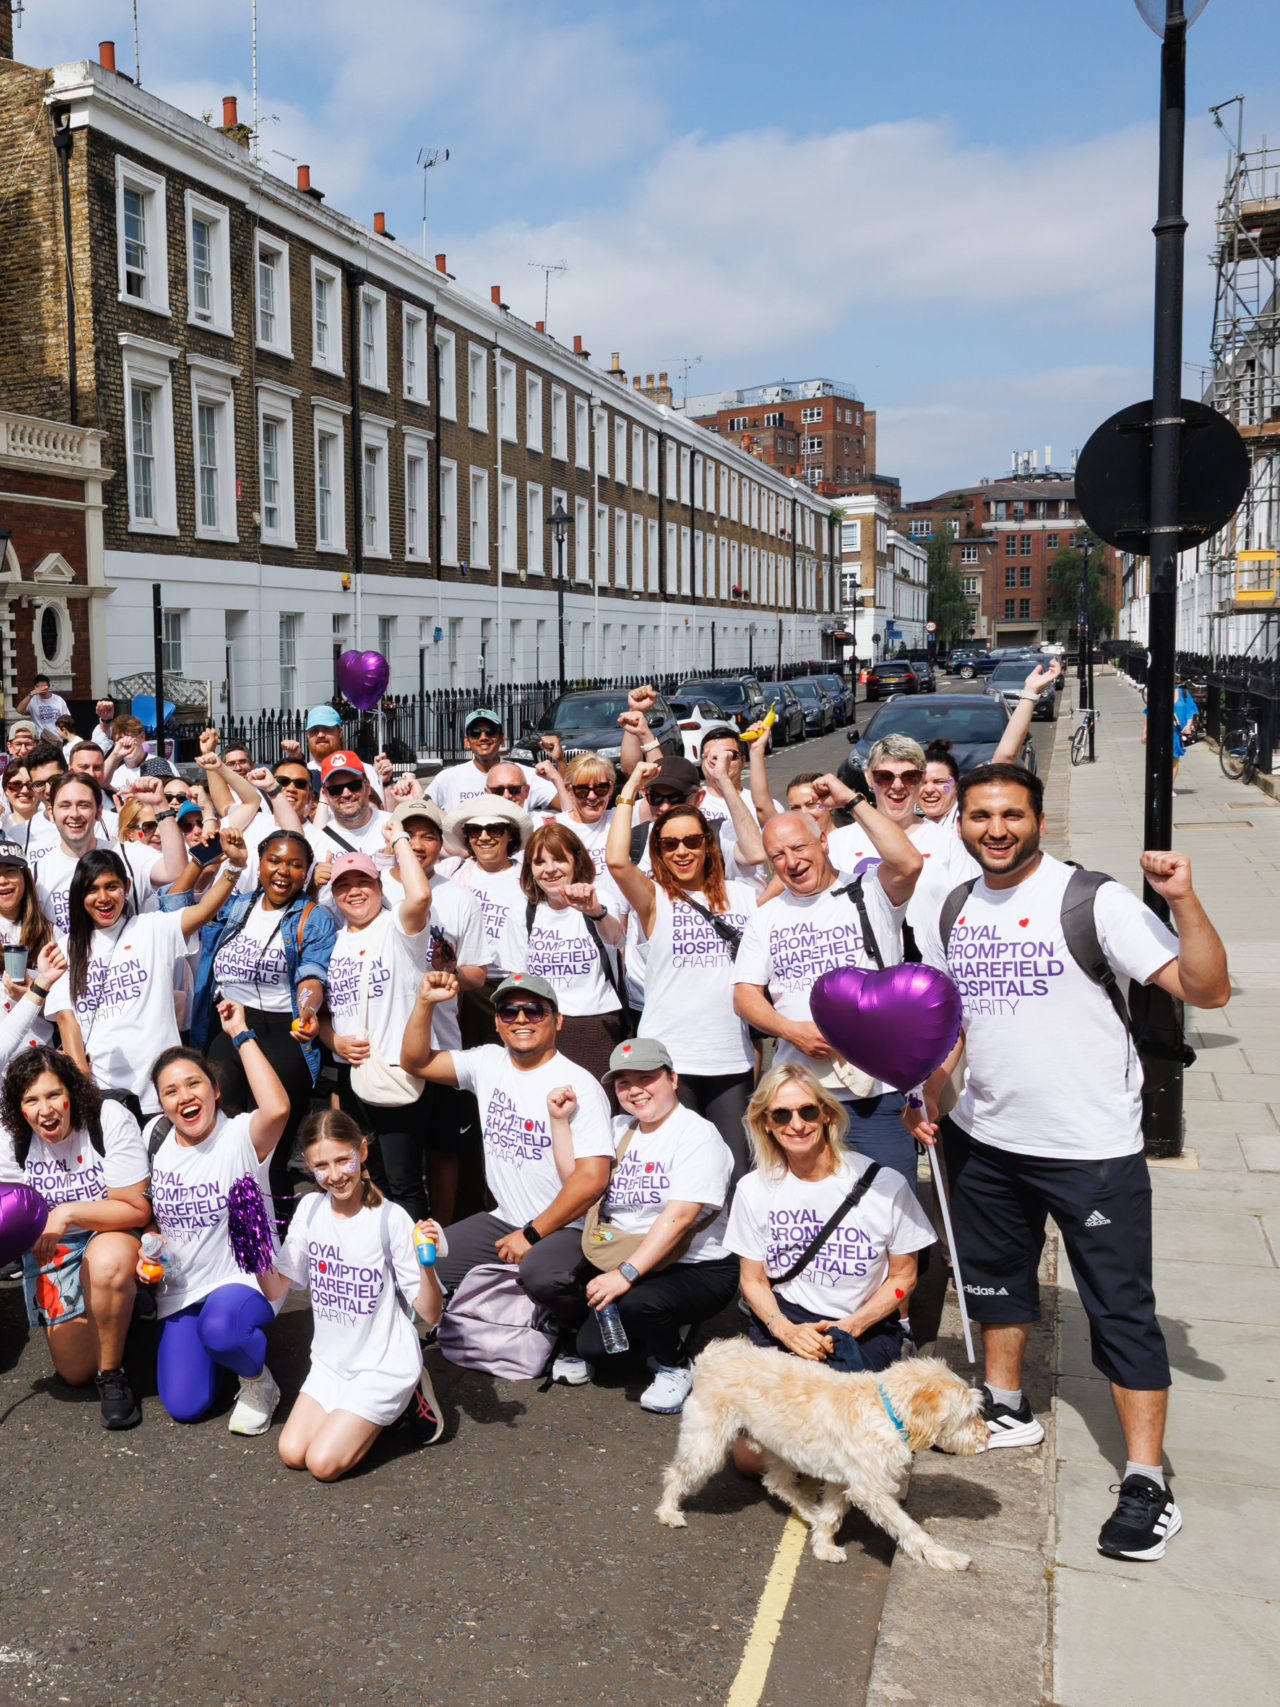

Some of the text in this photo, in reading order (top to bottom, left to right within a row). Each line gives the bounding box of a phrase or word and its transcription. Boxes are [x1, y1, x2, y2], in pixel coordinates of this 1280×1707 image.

[235, 934, 262, 948] OYAL
[532, 926, 562, 940] OYAL
[770, 921, 819, 943] ROYAL
[770, 923, 857, 956] BROMPTON
[950, 925, 1002, 942] ROYAL
[529, 935, 592, 951] OMPTON
[673, 941, 728, 955] HOSPIT
[948, 941, 1054, 960] BROMPTON
[330, 957, 354, 968] OYA
[528, 949, 598, 964] HAREFIELD
[773, 936, 865, 970] &HAREFIELD
[87, 959, 140, 984] OMPTON
[215, 962, 280, 985] HOSPITALS
[528, 963, 590, 976] OSPITALS
[774, 954, 856, 980] HOSPITALS
[77, 970, 148, 999] AREFIELD
[957, 979, 1049, 997] OSPITALS
[76, 986, 141, 1013] OSPITALS
[962, 999, 1020, 1016] HARITY
[77, 1003, 125, 1027] HARITY
[488, 1101, 545, 1133] BRTON
[484, 1128, 542, 1160] HOSALS
[27, 1159, 71, 1175] ROYAL
[153, 1168, 183, 1186] OYAL
[611, 1175, 670, 1191] AREFIELD
[42, 1180, 106, 1202] AREFIEL
[152, 1181, 220, 1201] ROMPTON
[608, 1191, 661, 1204] SPITALS
[153, 1195, 228, 1216] AREFIELD
[156, 1214, 220, 1229] SPITALS
[769, 1209, 824, 1225] ROYAL
[1084, 1218, 1111, 1228] adidas
[162, 1229, 203, 1243] ARITY
[771, 1225, 871, 1243] BROMTON
[308, 1241, 344, 1262] OYAL
[767, 1241, 879, 1260] &HAFIELD
[309, 1257, 383, 1282] ROMPTON
[766, 1253, 866, 1276] HOSITALS
[310, 1272, 383, 1298] HAREFIEL
[311, 1288, 377, 1315] OSPITALS
[313, 1306, 357, 1328] HARITY
